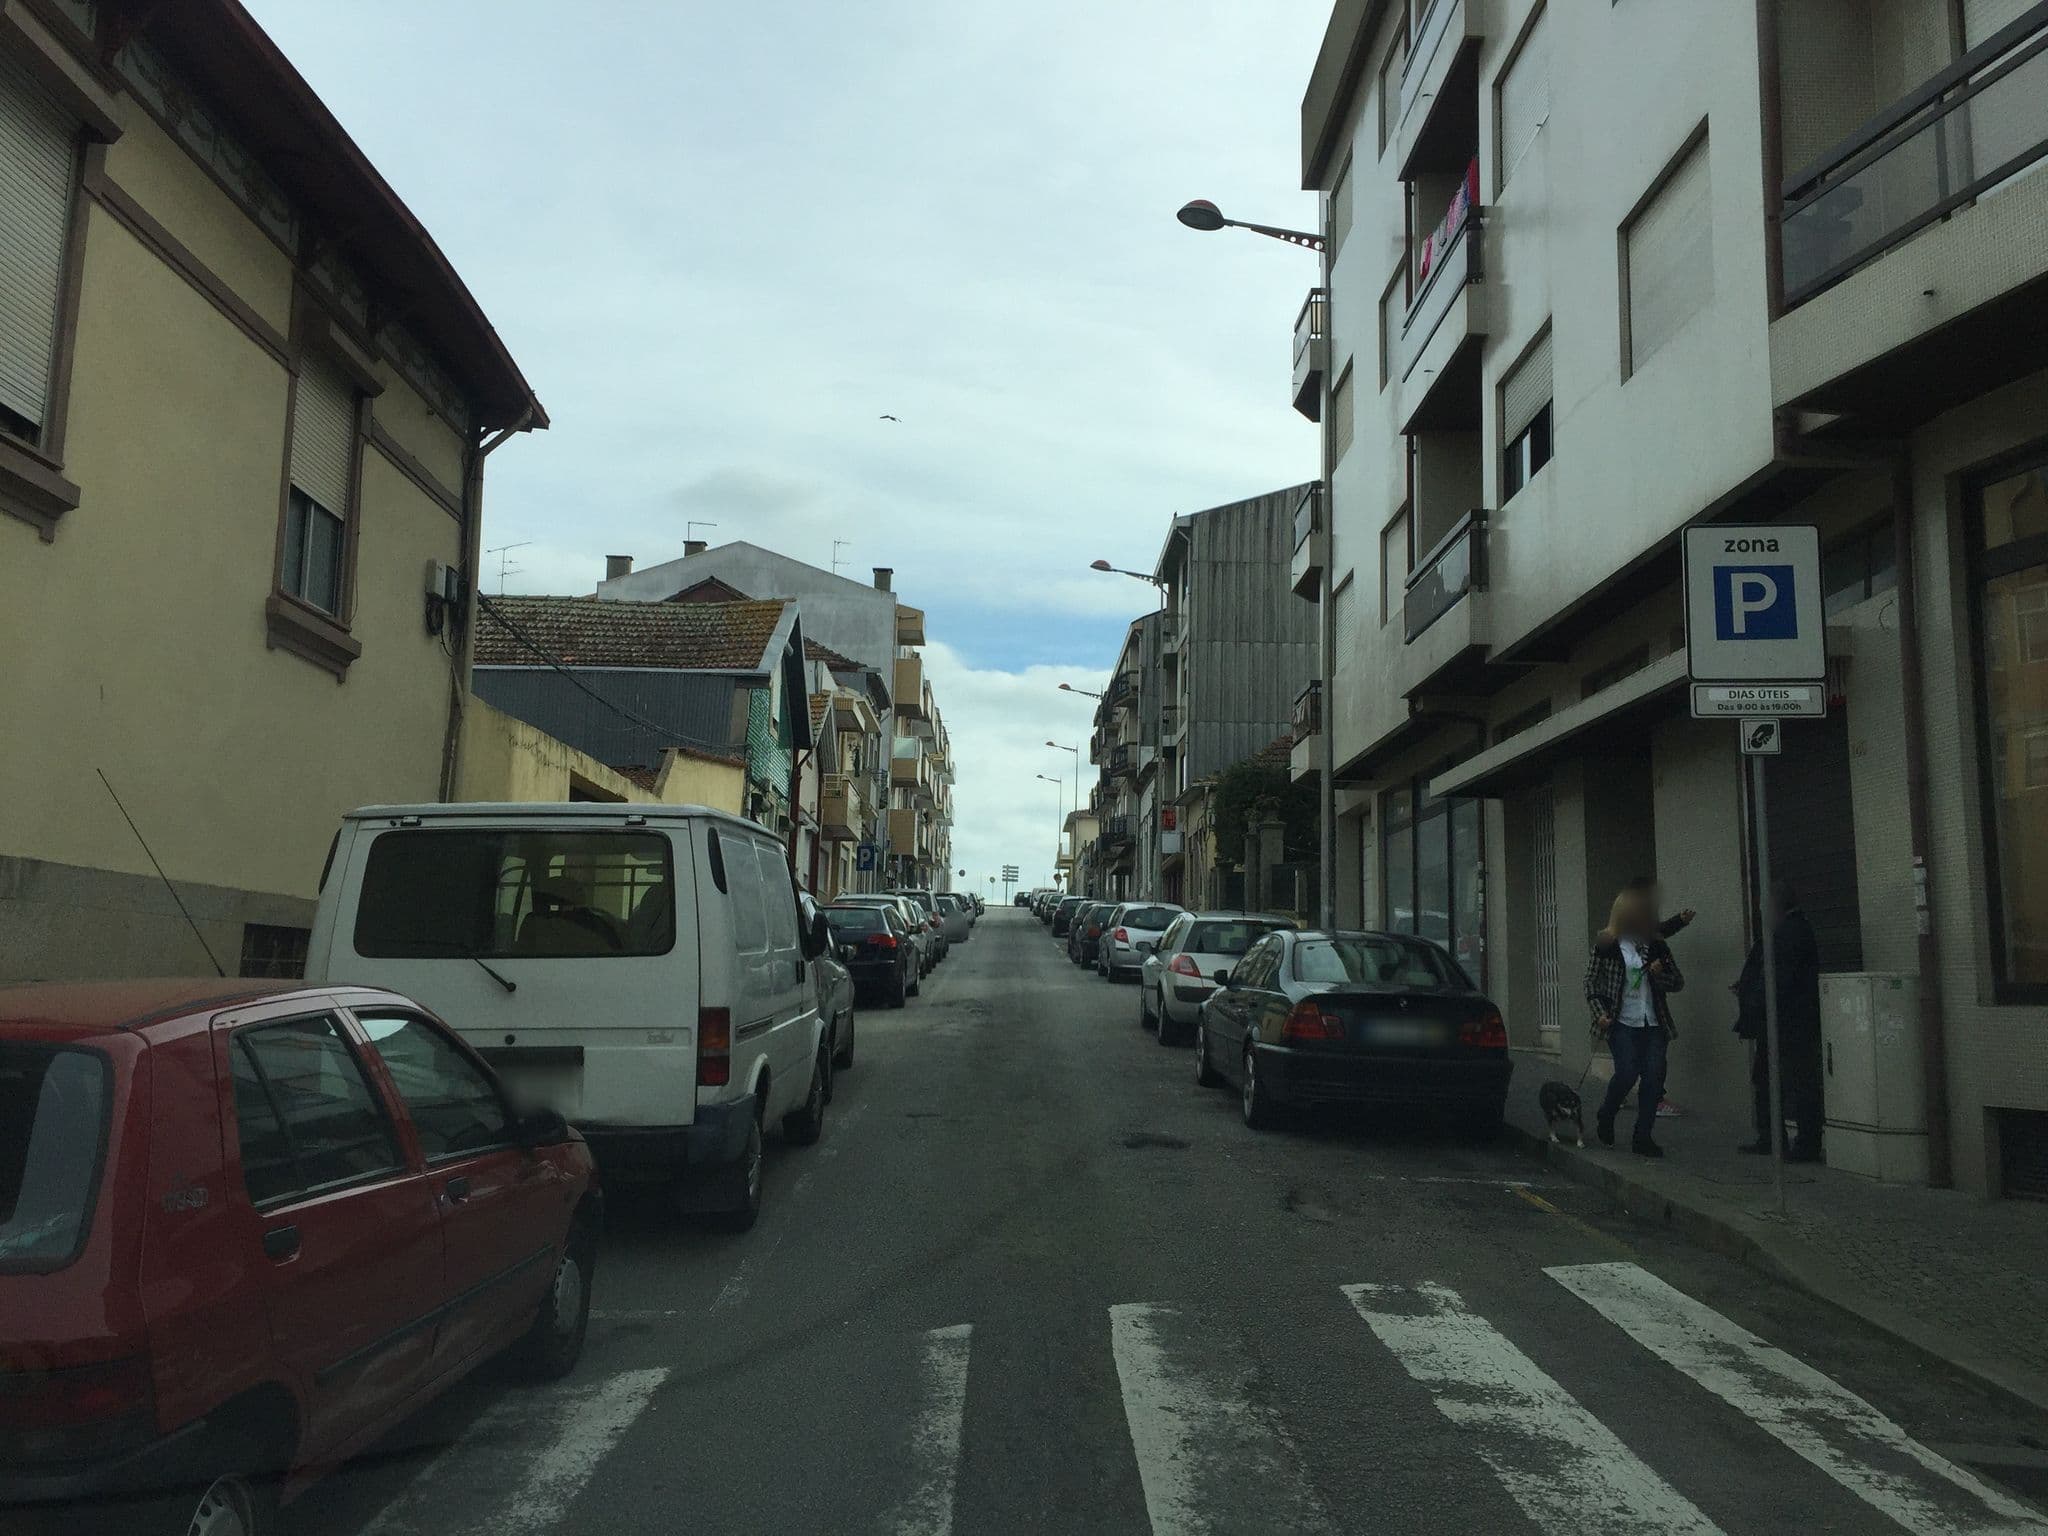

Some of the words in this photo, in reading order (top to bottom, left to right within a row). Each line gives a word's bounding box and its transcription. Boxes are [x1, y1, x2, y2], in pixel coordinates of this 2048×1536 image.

[1724, 538, 1780, 553] zona
[1730, 572, 1778, 634] P
[1728, 690, 1755, 699] DIAS
[1758, 689, 1790, 699] ÚTEIS
[1717, 703, 1735, 711] Das
[860, 848, 871, 868] P
